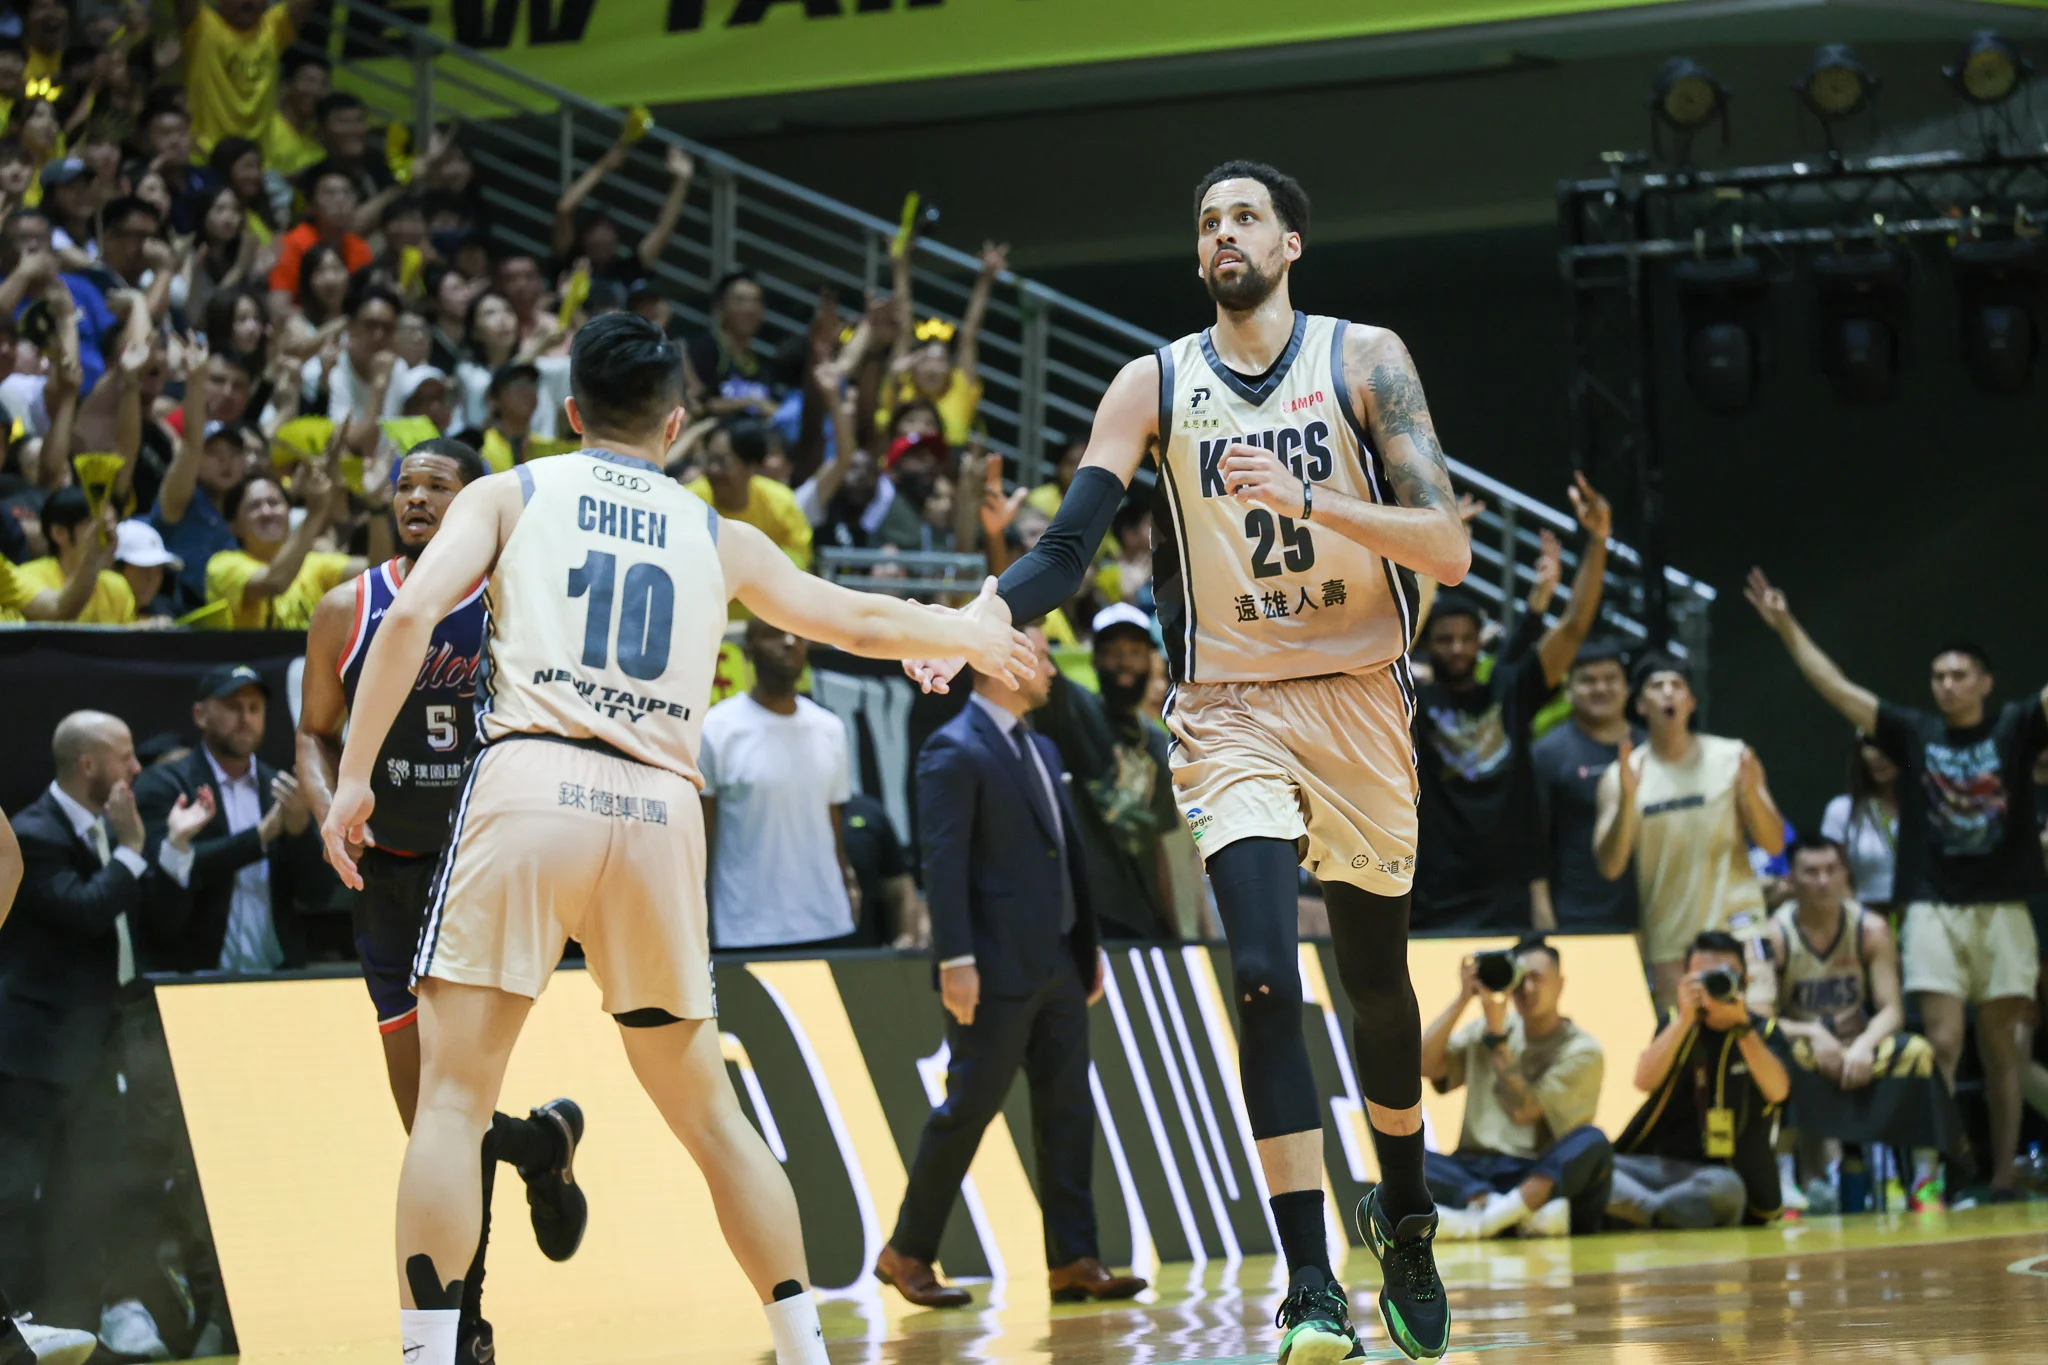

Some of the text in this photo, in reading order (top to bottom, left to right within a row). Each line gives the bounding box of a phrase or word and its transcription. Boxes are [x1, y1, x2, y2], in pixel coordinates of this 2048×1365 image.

[1282, 391, 1324, 414] SAMPO
[1199, 420, 1332, 498] KGS
[578, 495, 667, 549] CHIEN
[1245, 508, 1315, 578] 25
[567, 550, 675, 682] 10
[1234, 579, 1347, 622] 遠雄人壽
[533, 668, 691, 721] NEW TAIPEI
[426, 705, 457, 751] 5
